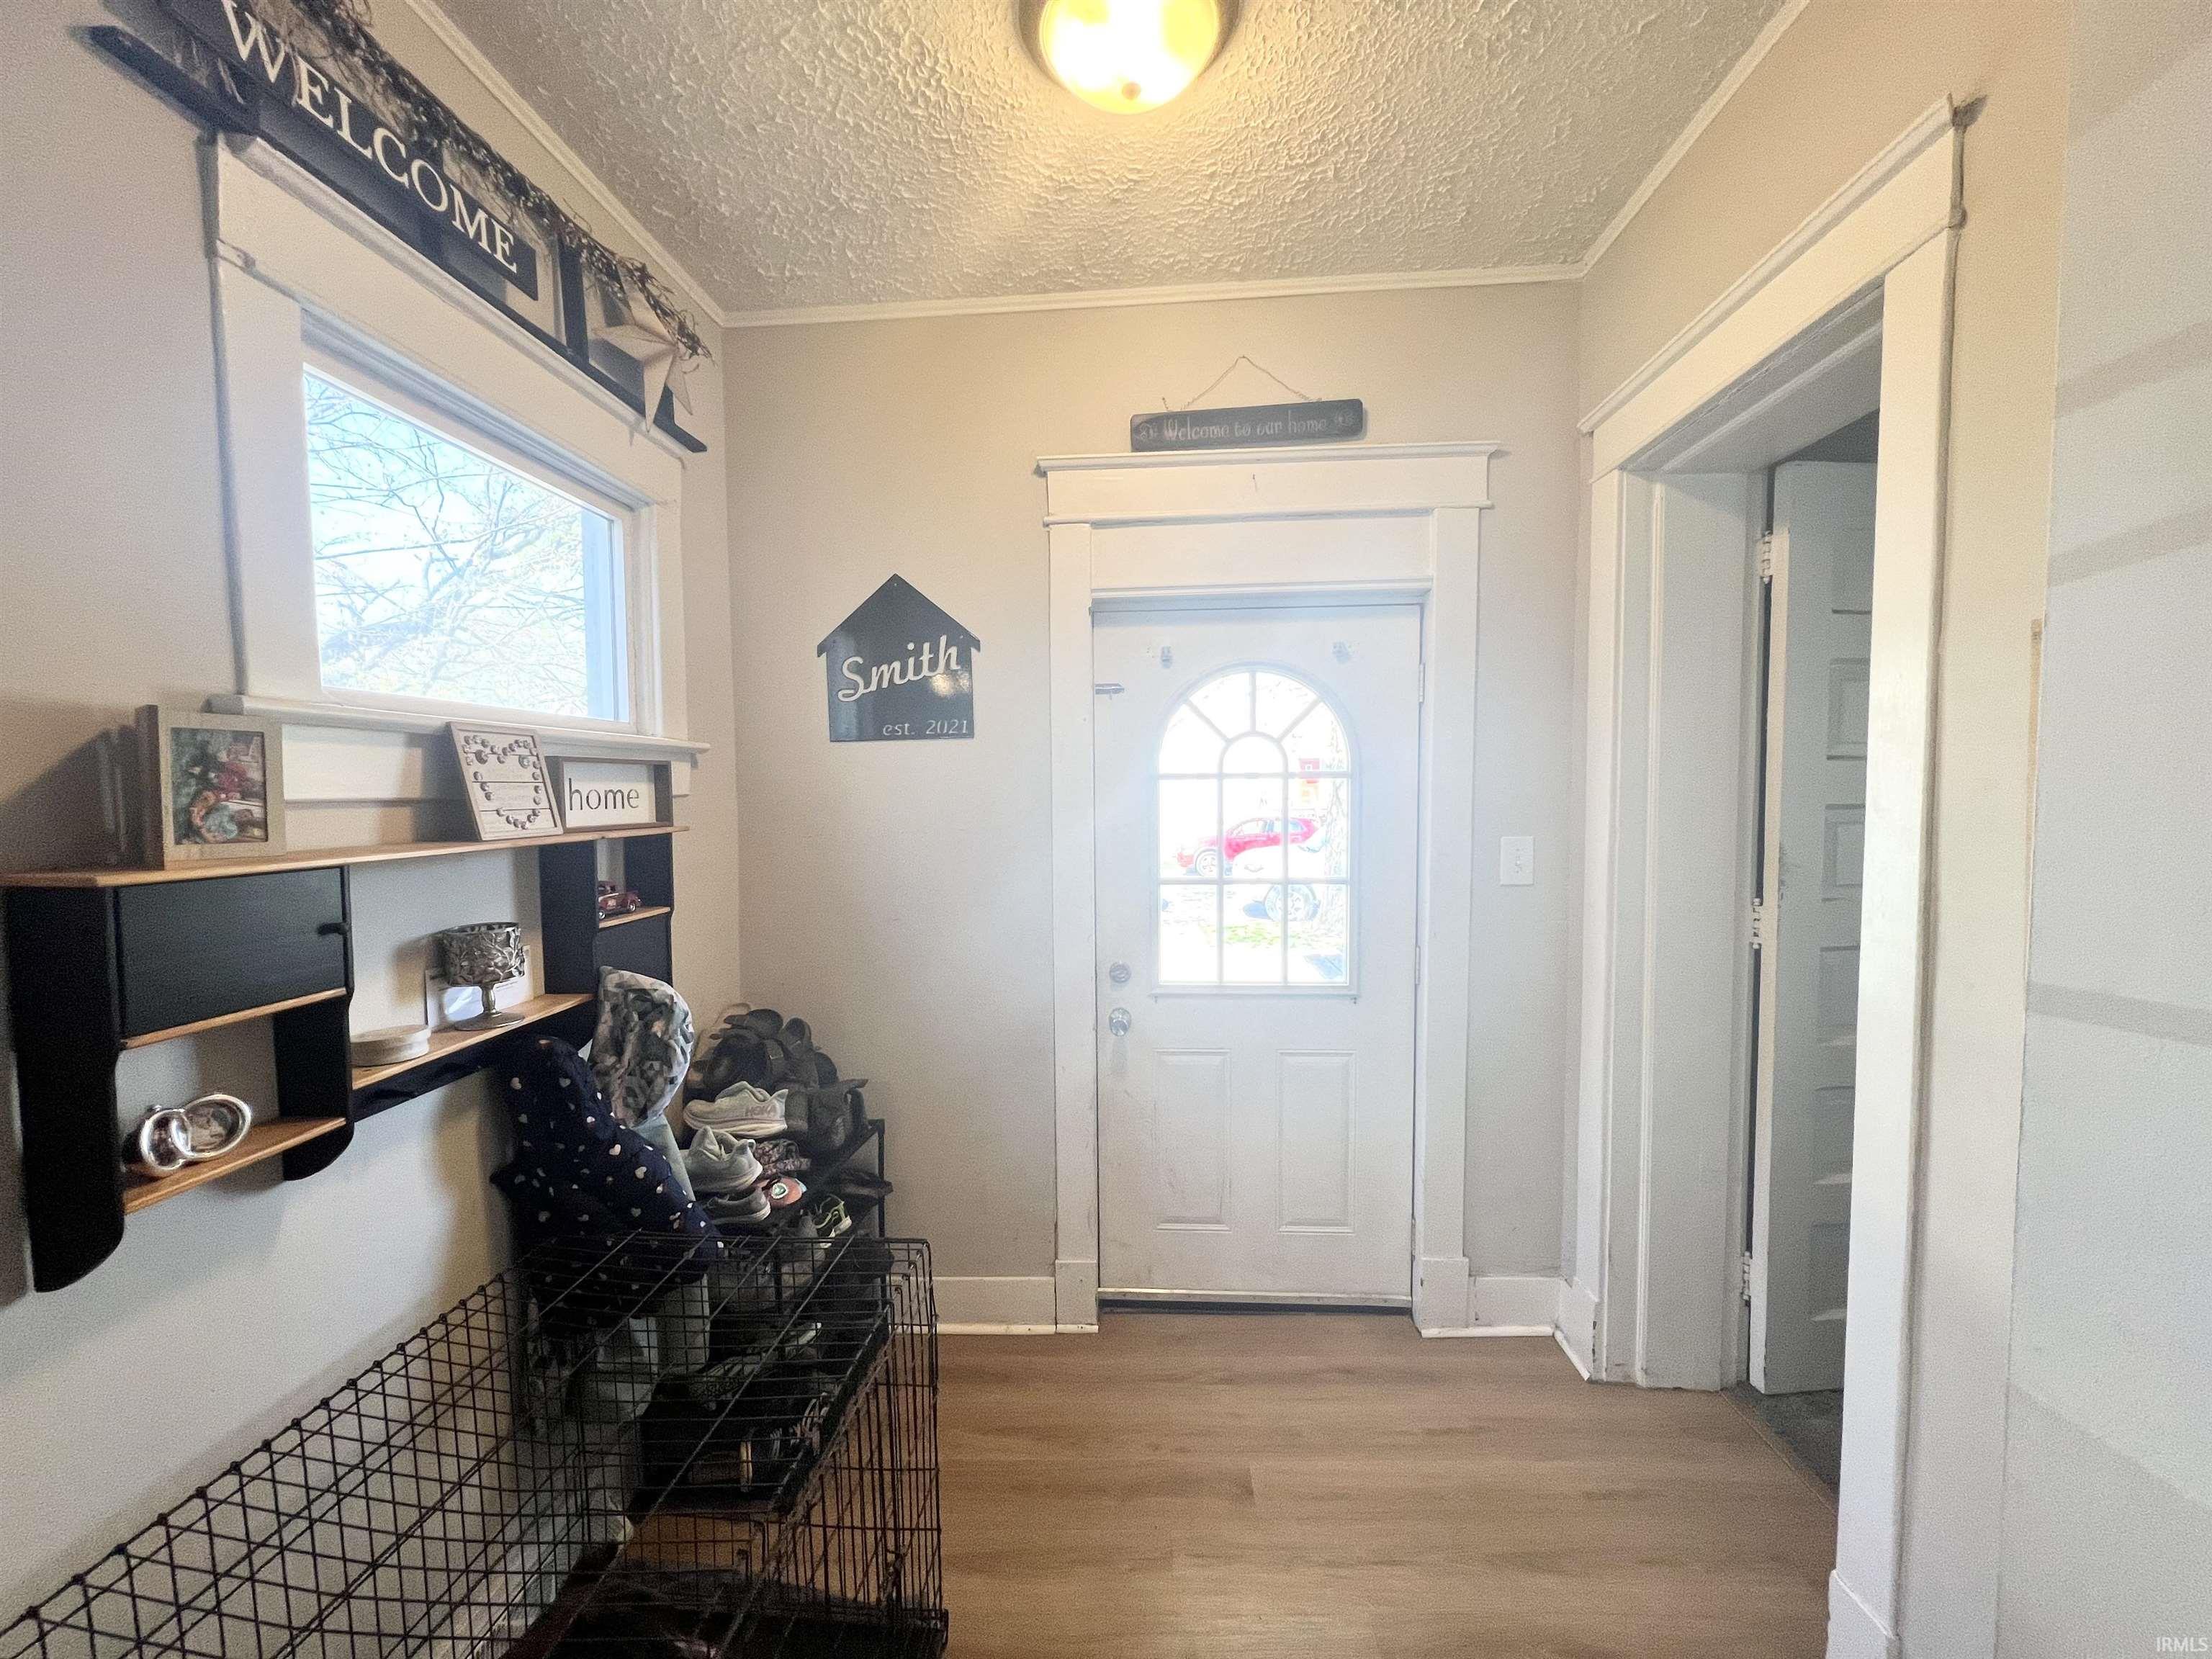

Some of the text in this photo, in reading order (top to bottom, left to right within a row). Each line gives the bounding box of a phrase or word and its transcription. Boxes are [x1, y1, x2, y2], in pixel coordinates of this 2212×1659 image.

[222, 0, 517, 274] WELCOME
[1164, 410, 1327, 441] Welcome to our home
[837, 634, 961, 701] Smith
[883, 720, 968, 736] est. 2021
[569, 778, 639, 811] home
